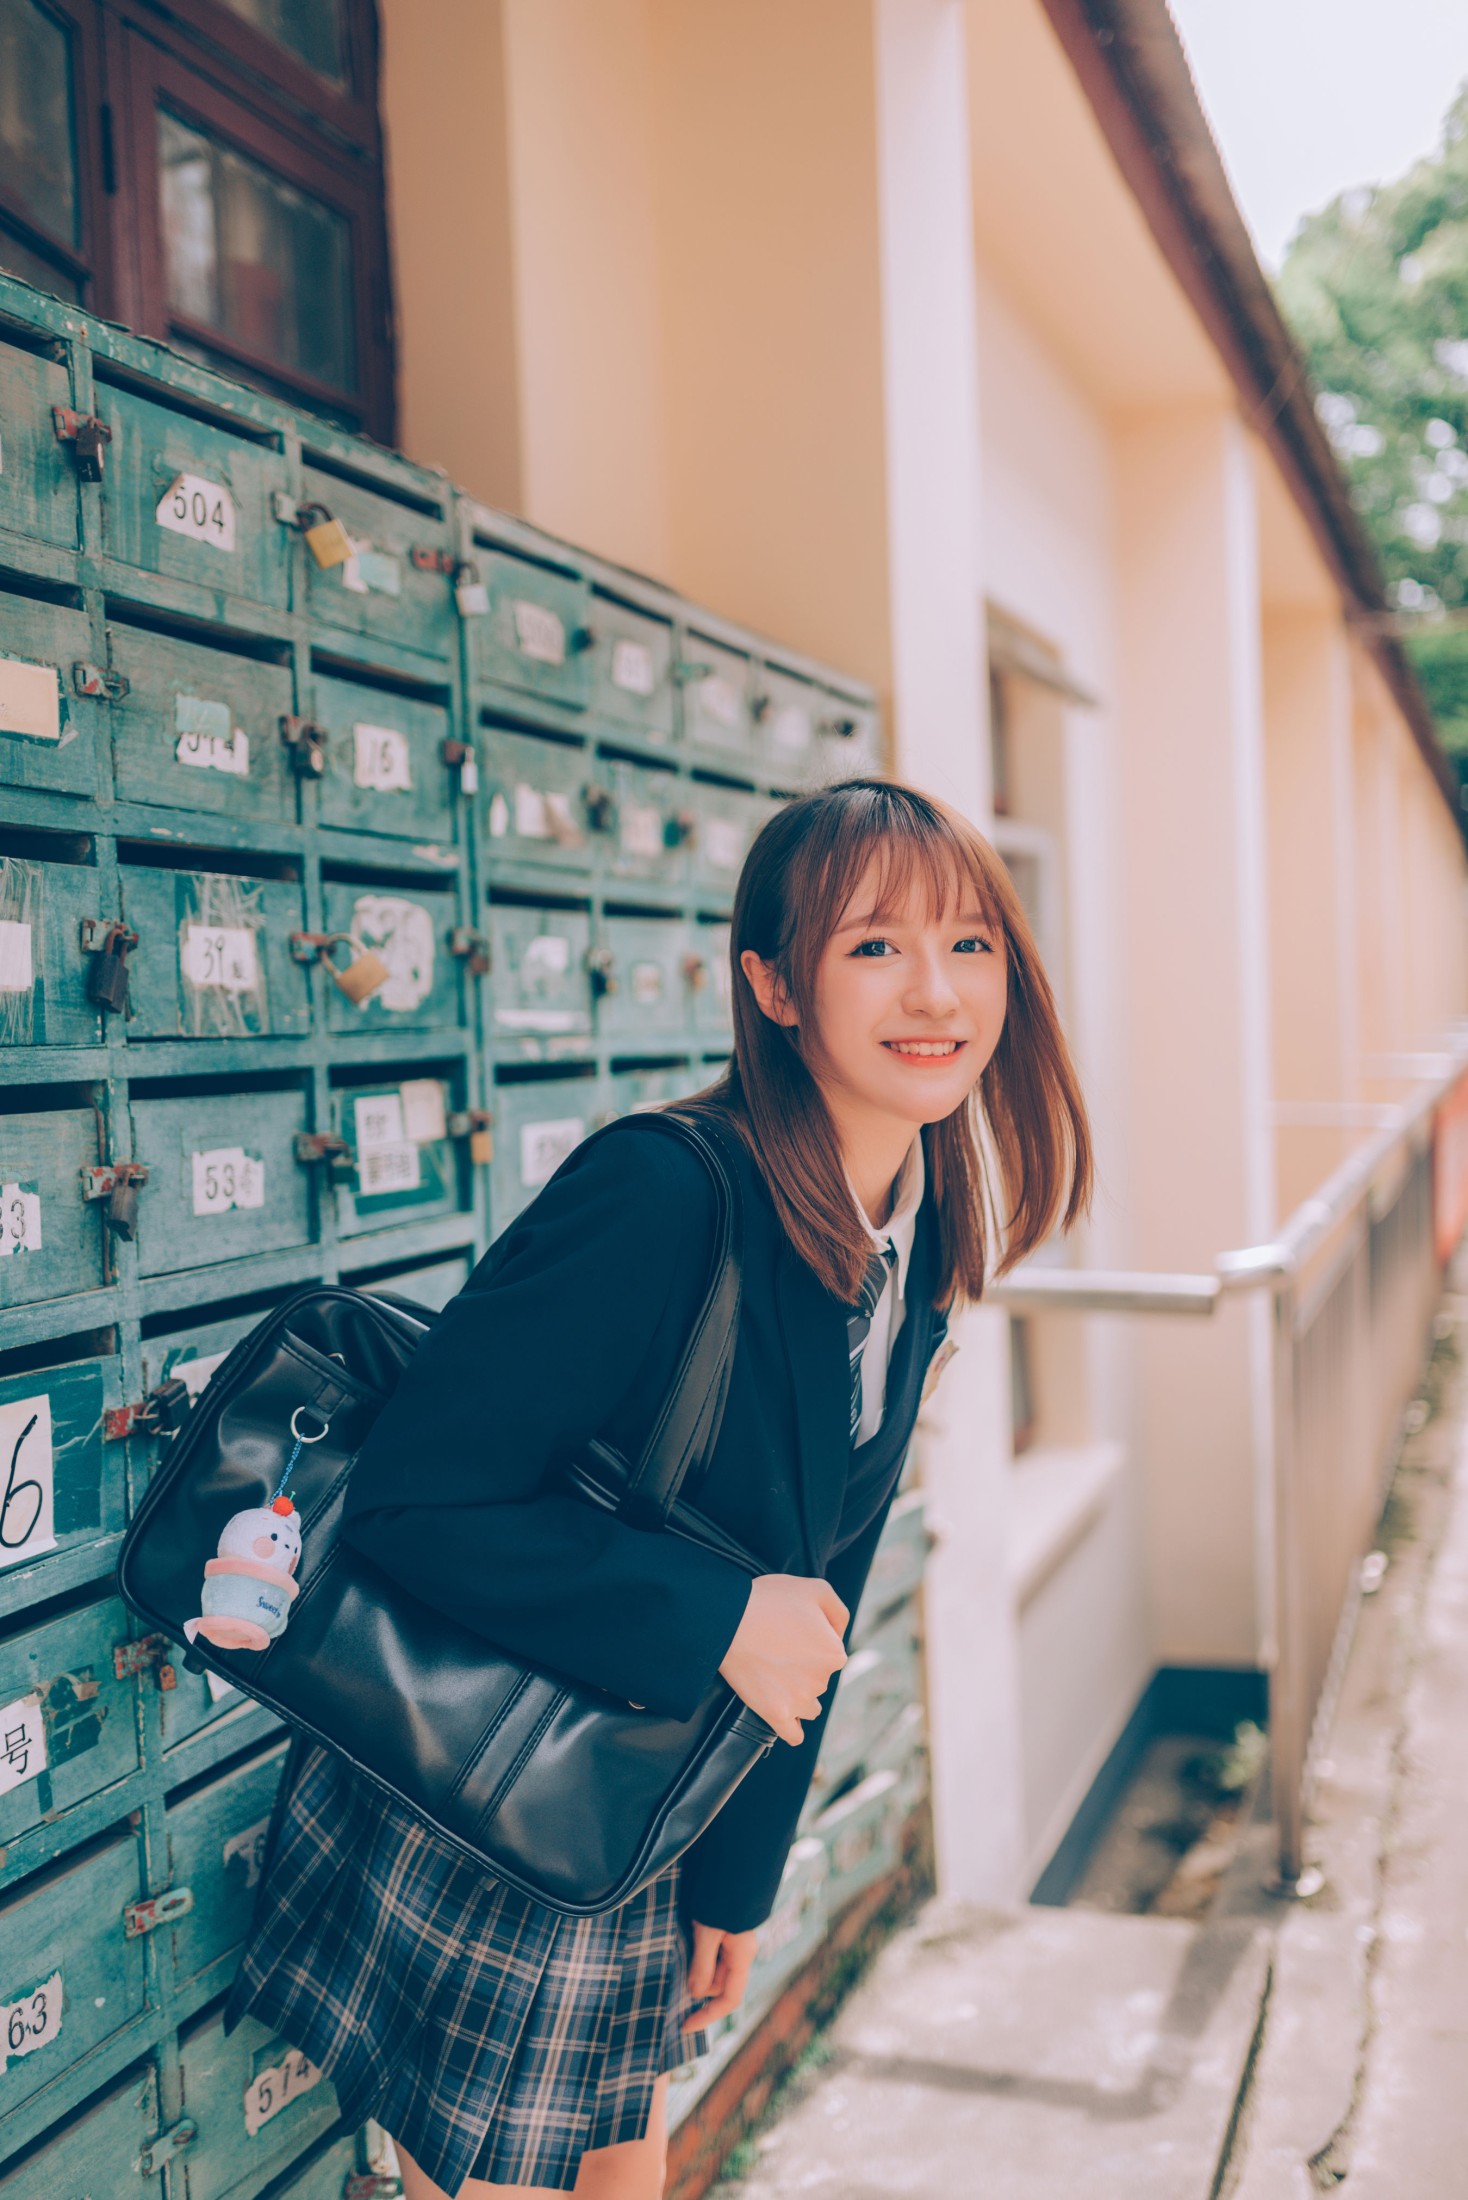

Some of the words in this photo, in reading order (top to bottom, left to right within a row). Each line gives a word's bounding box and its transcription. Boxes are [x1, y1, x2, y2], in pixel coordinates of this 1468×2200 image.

[174, 485, 225, 534] 504
[205, 1164, 236, 1200] 53
[0, 1200, 26, 1240] 3
[0, 1723, 32, 1775] 号
[8, 1992, 47, 2050] 63
